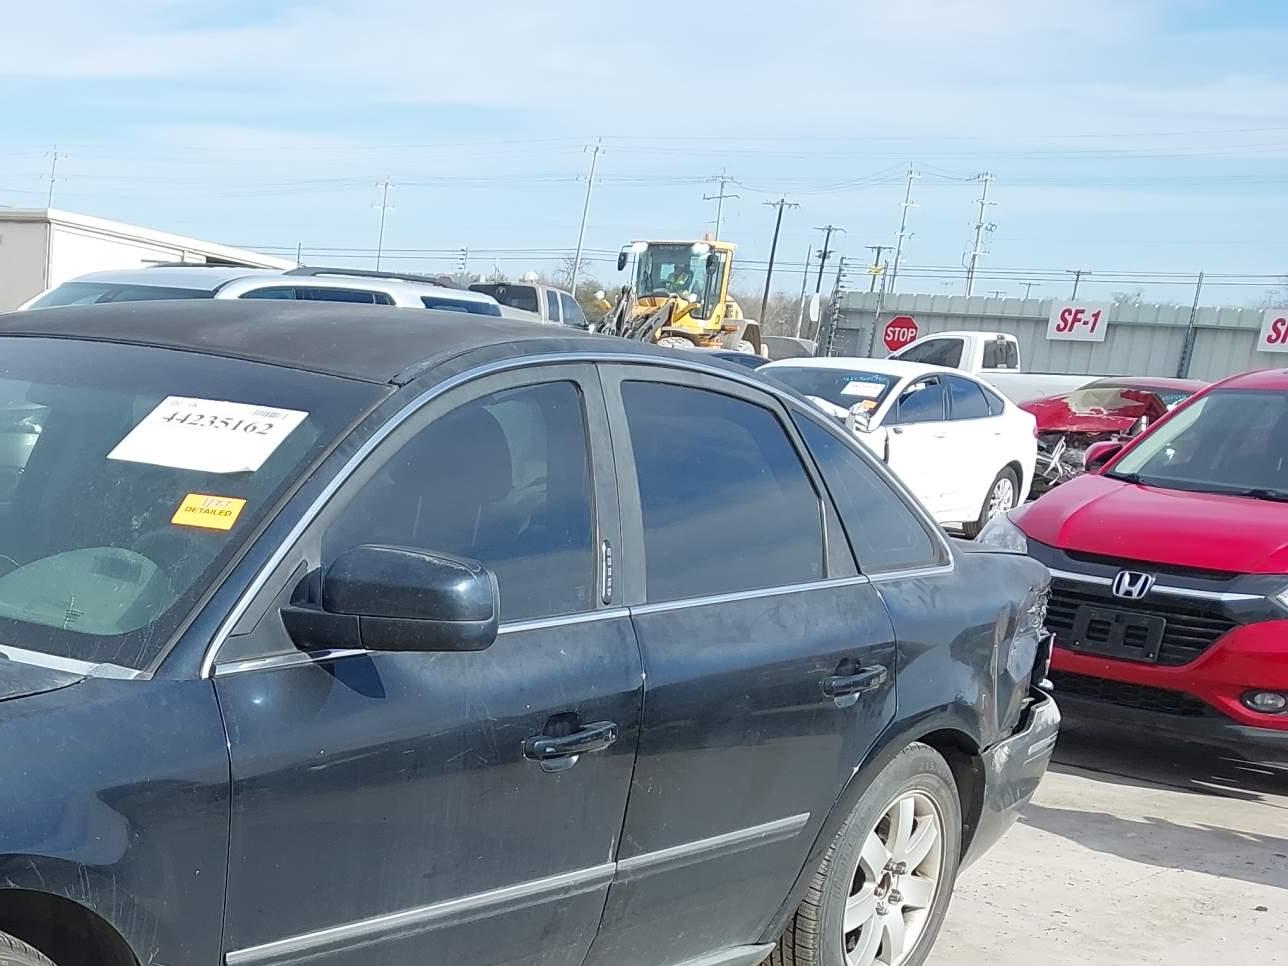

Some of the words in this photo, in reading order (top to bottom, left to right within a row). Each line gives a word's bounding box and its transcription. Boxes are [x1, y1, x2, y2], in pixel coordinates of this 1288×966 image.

[1055, 308, 1102, 333] SF-1
[885, 326, 916, 342] STOP
[163, 411, 274, 435] 44235162
[184, 506, 232, 517] DETAILED
